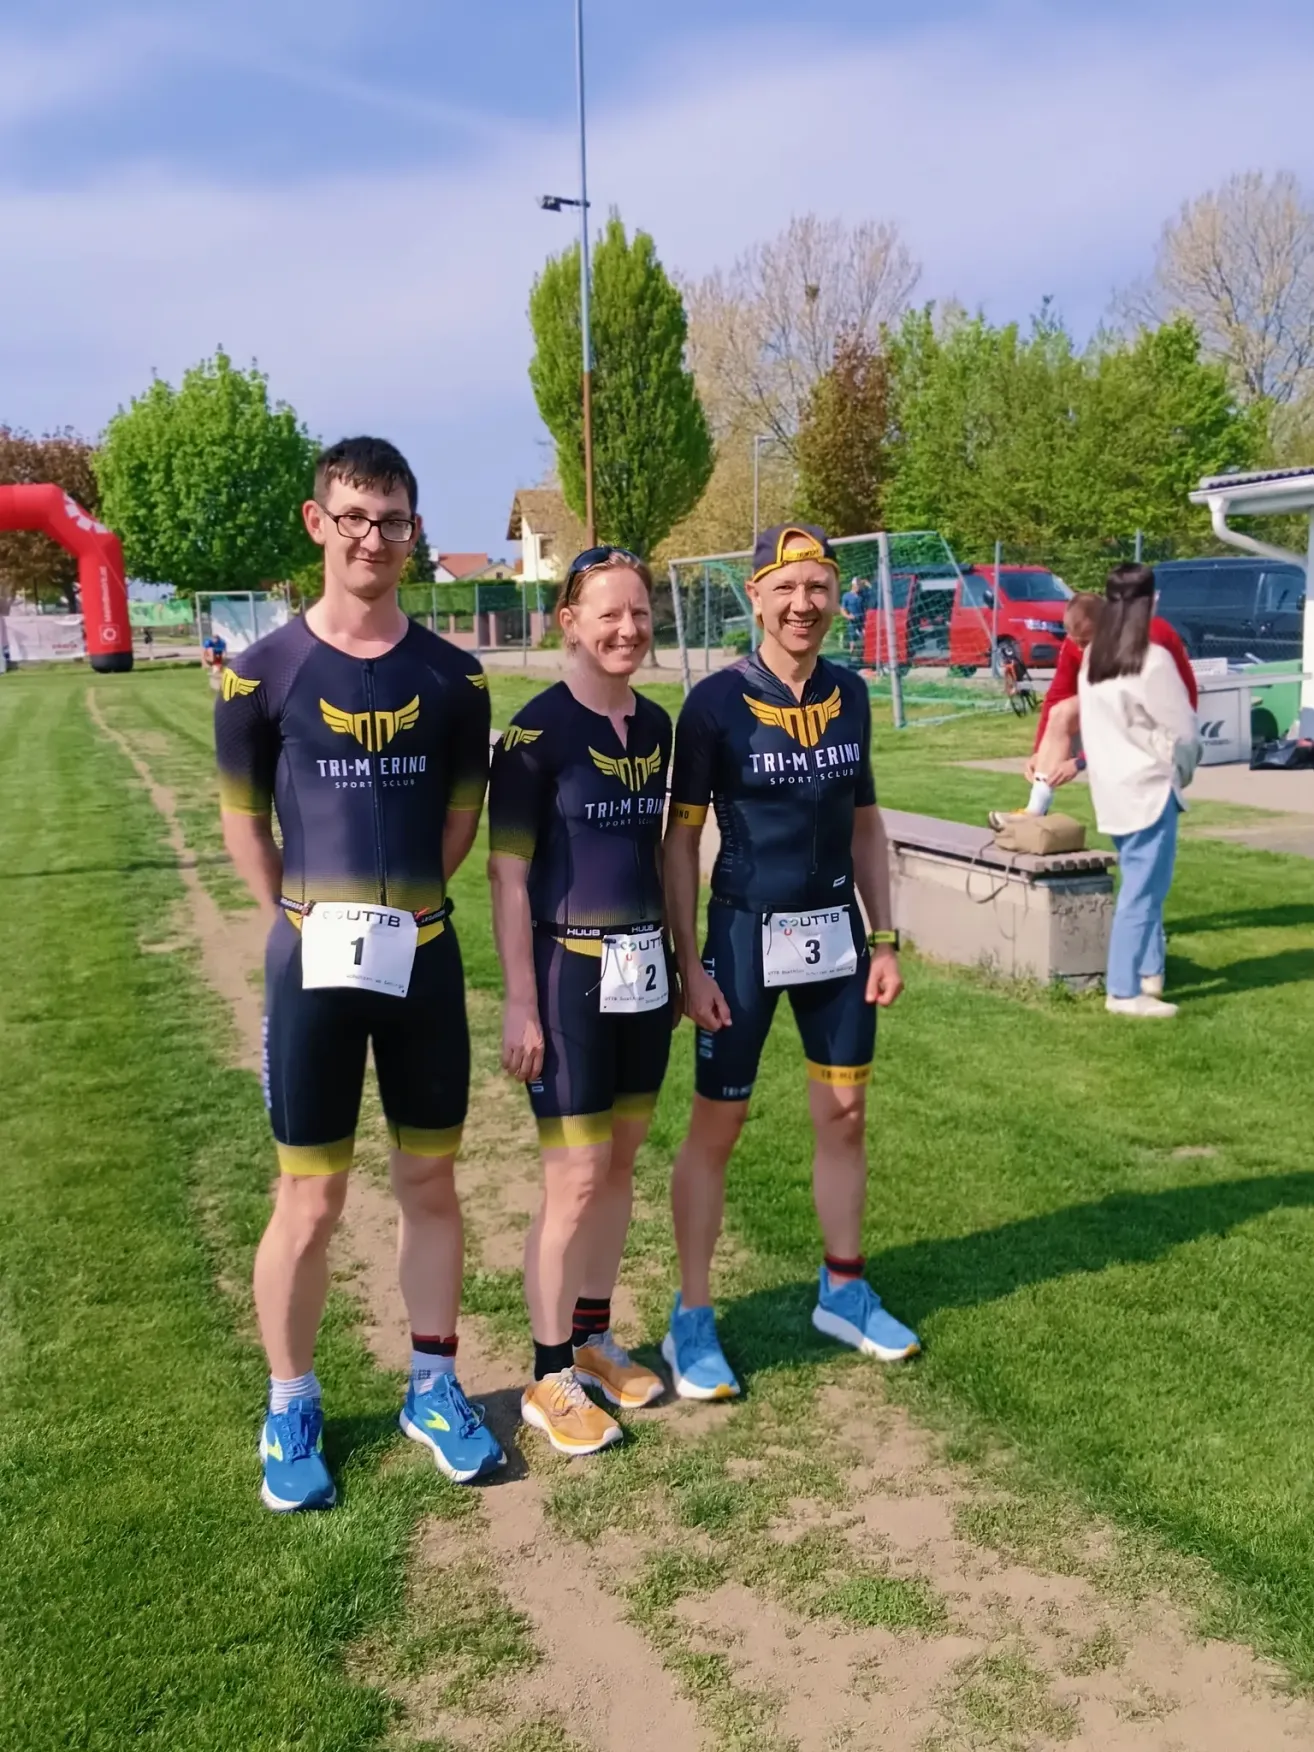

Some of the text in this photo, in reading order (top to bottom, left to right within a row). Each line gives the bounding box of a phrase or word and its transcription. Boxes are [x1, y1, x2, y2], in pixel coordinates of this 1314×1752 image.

[346, 910, 401, 928] UTTB
[566, 924, 654, 936] HUUB HUUB
[800, 912, 840, 927] UTTB
[350, 936, 366, 966] 1
[805, 939, 821, 965] 3
[645, 963, 657, 992] 2
